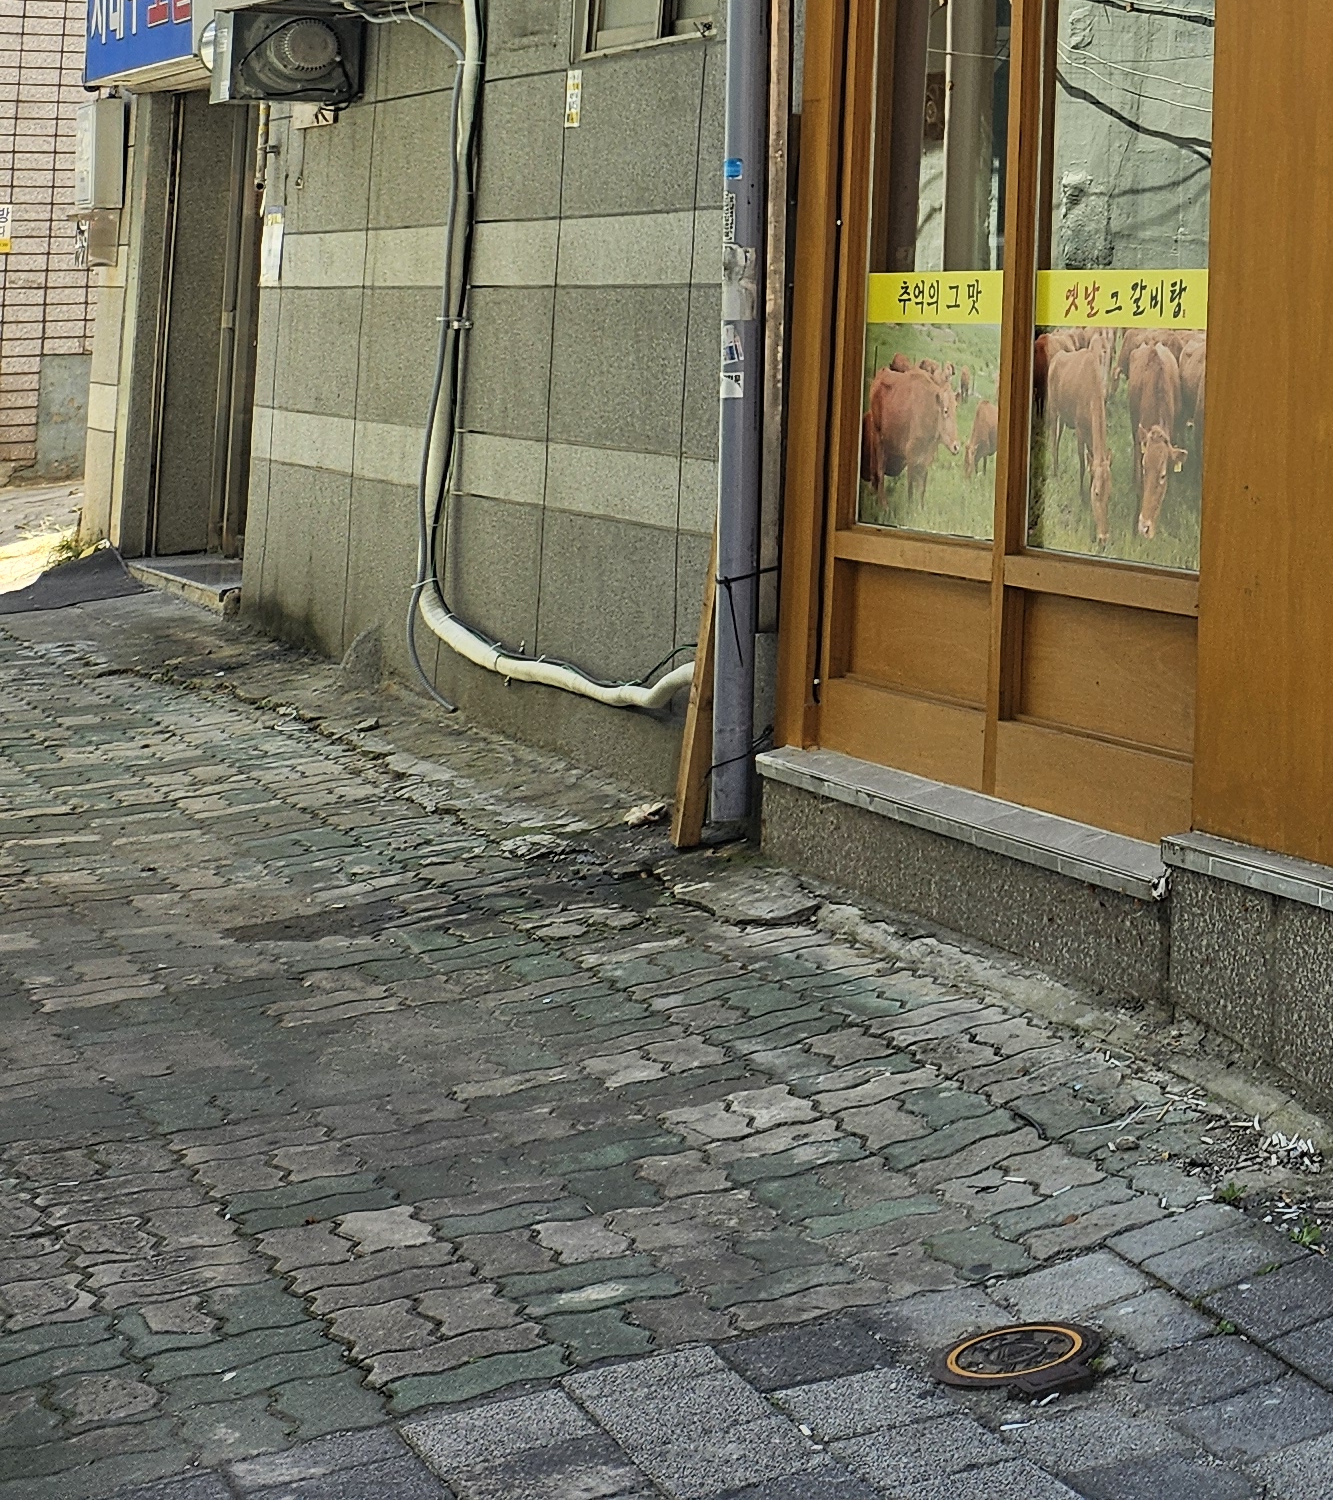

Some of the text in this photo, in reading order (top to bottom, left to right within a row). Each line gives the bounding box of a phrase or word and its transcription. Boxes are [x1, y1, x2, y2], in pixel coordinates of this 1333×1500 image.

[897, 278, 982, 316] 추억의 그 맛
[1064, 278, 1188, 319] 옛날 그 갈비탕
